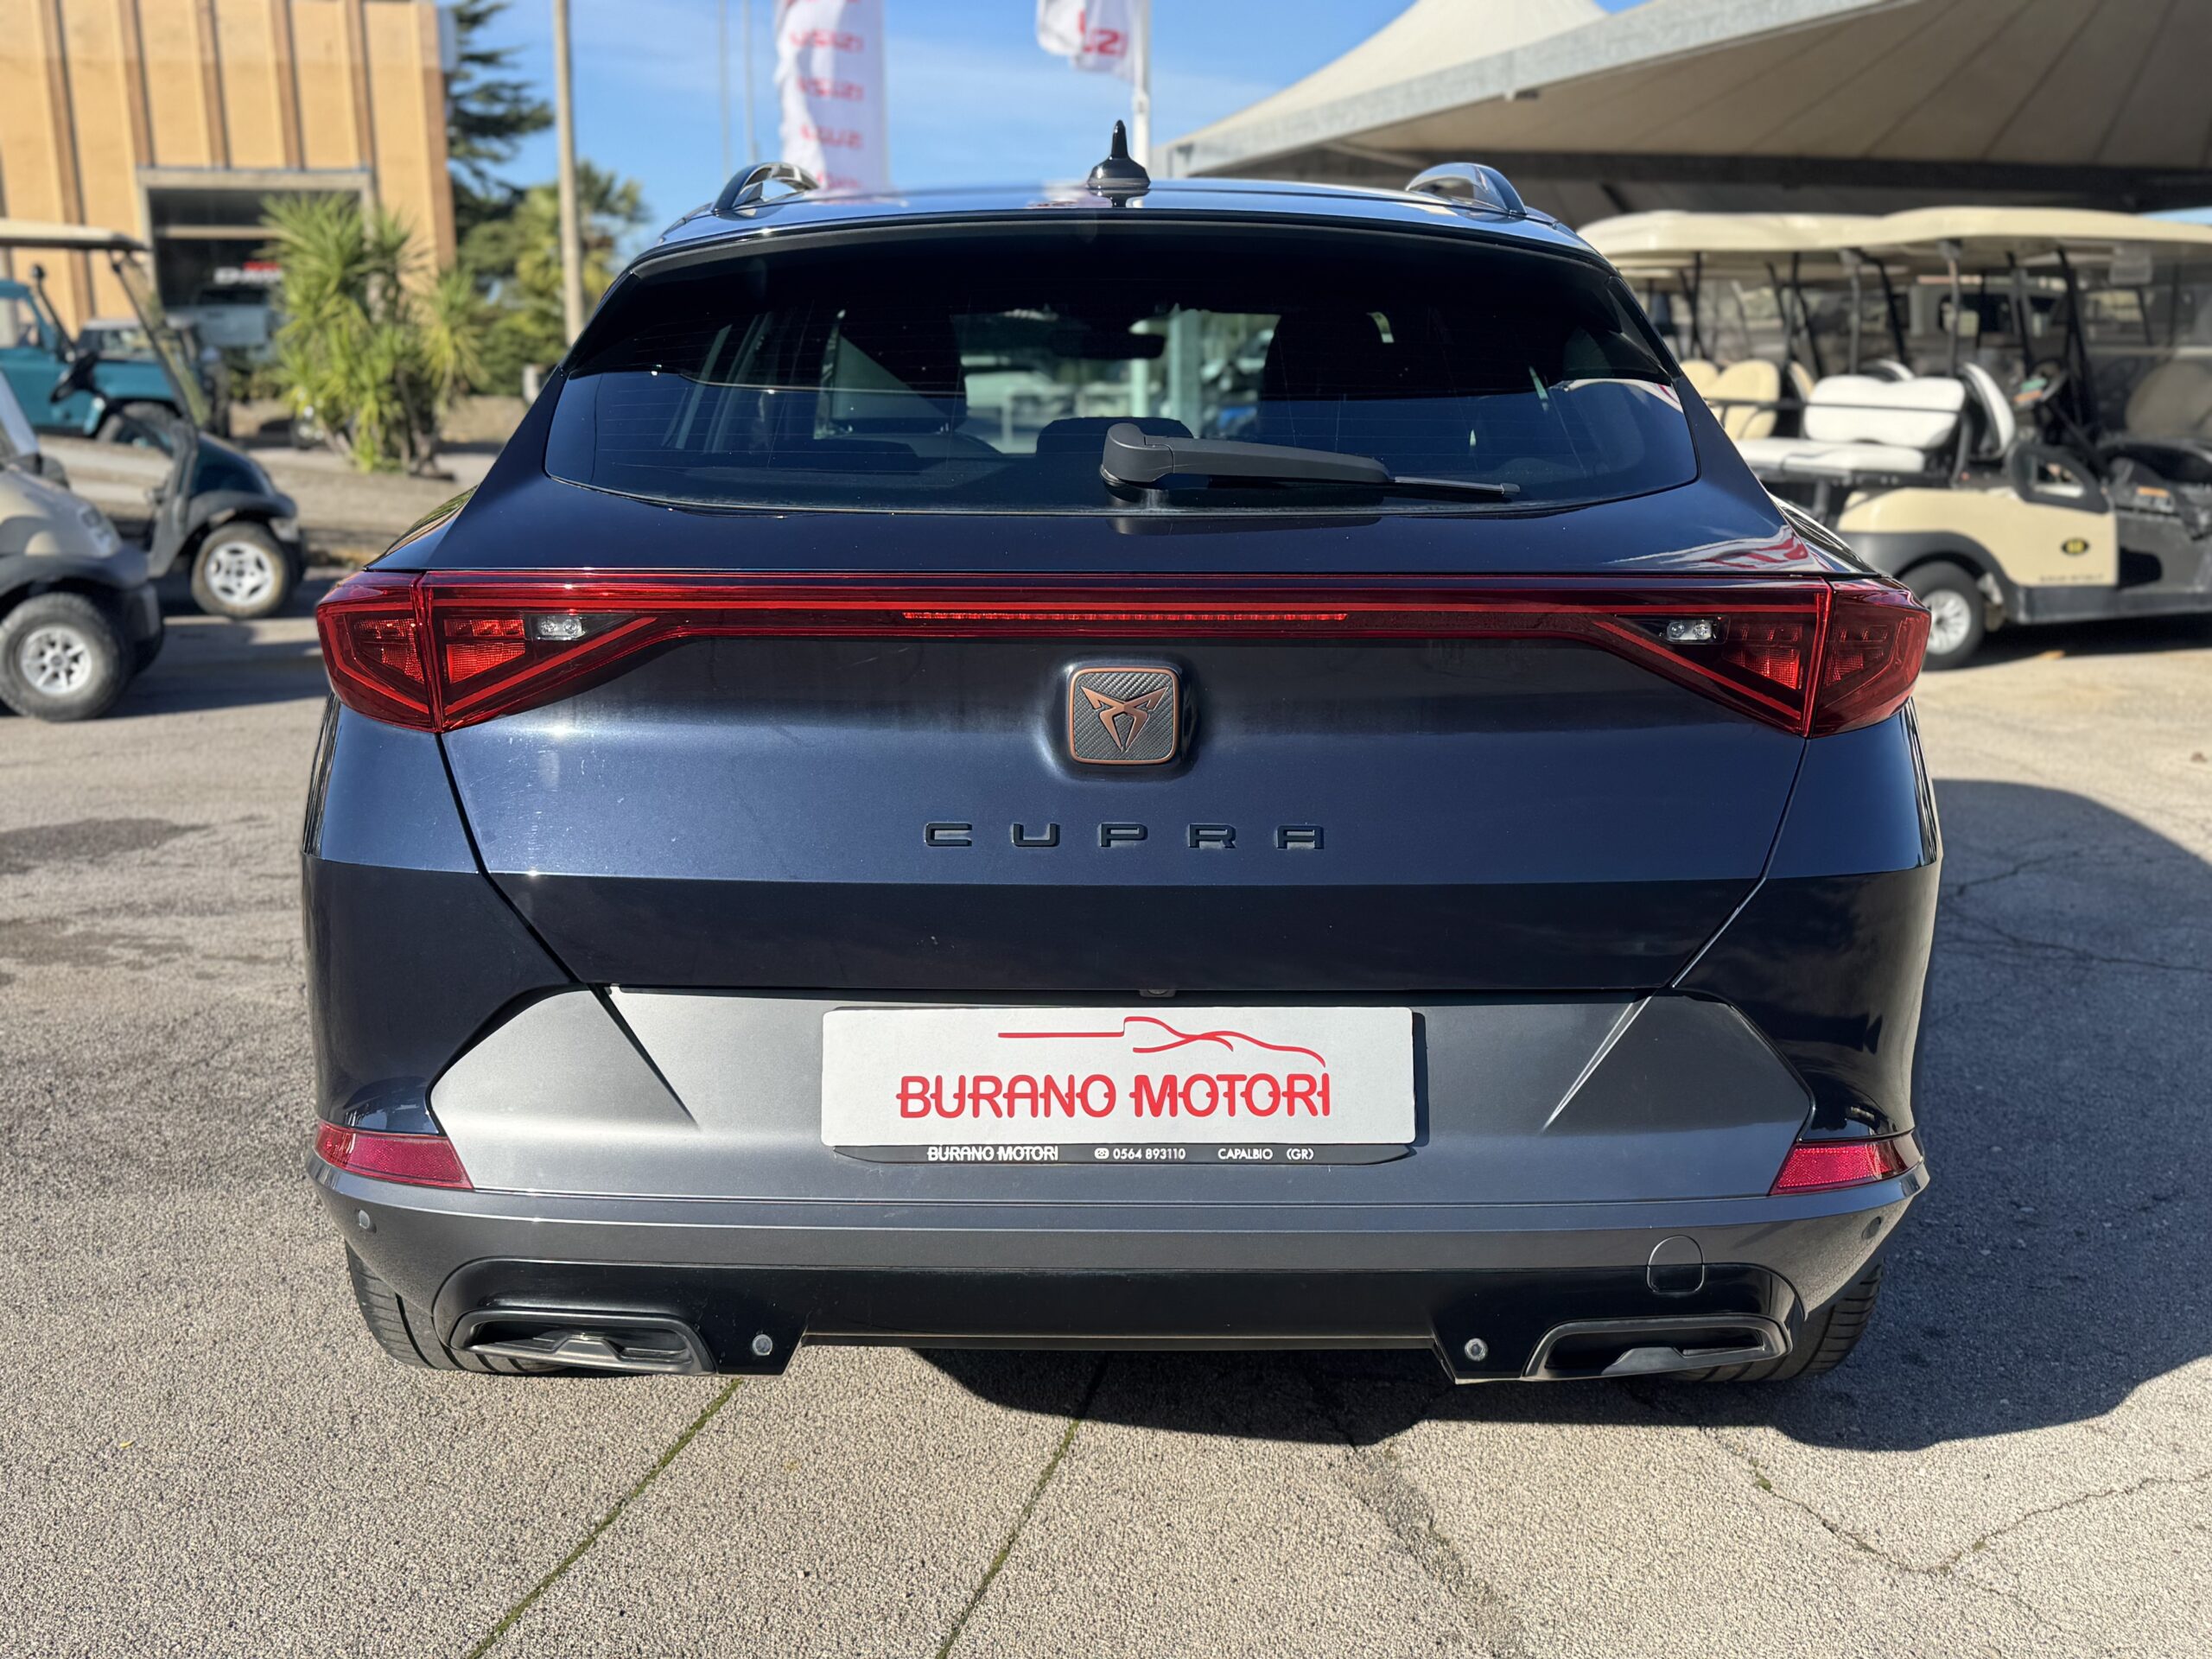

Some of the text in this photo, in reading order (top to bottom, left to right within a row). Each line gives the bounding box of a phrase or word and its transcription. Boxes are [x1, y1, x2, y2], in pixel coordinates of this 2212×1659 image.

[923, 821, 1325, 849] CUPRA
[896, 1073, 1330, 1118] BURANO MOTORI
[926, 1146, 1314, 1161] BURANO MOTORI 0564 893110 CAPALBIO (GR)
